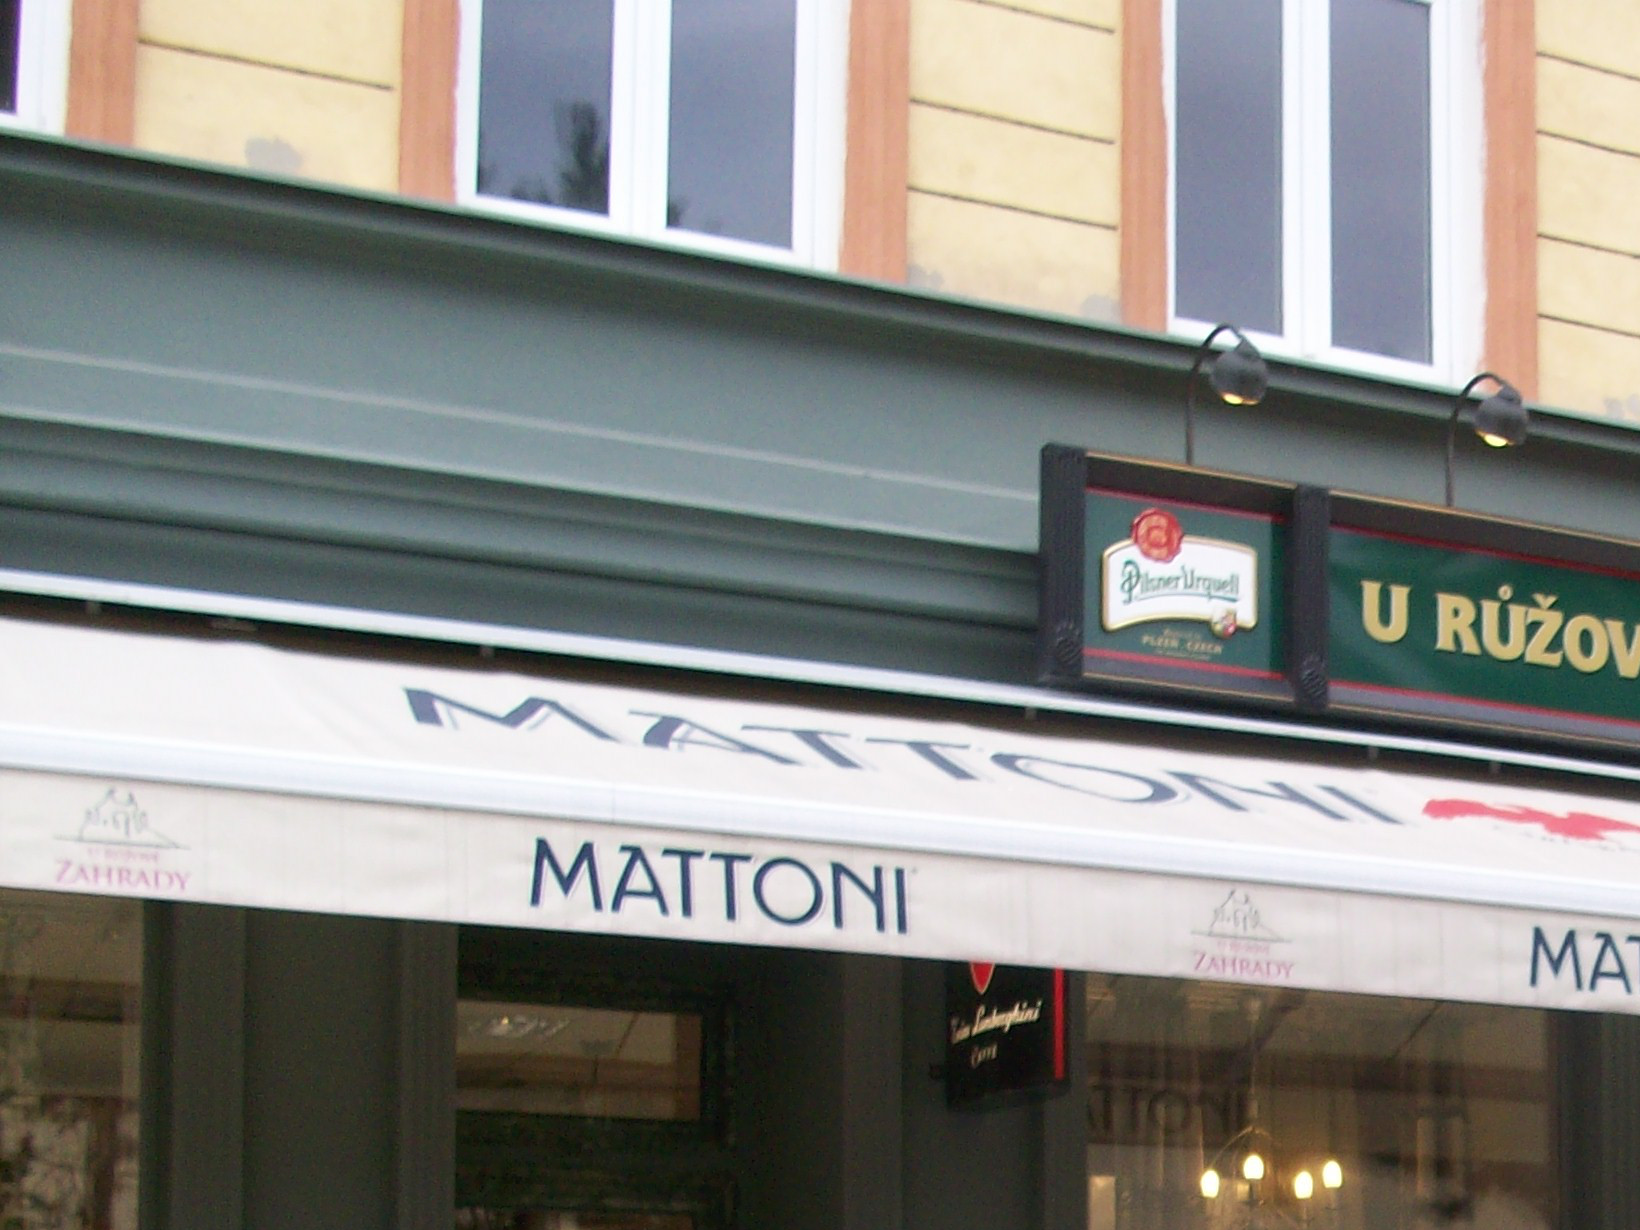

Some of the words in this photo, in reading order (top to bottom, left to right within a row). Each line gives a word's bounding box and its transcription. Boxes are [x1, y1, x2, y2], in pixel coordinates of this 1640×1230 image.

[1360, 580, 1411, 643] U
[402, 684, 1404, 826] MATTONI
[55, 857, 191, 891] ZAHRADY
[529, 836, 911, 935] MATTONI
[1194, 949, 1297, 980] ZAHRADY
